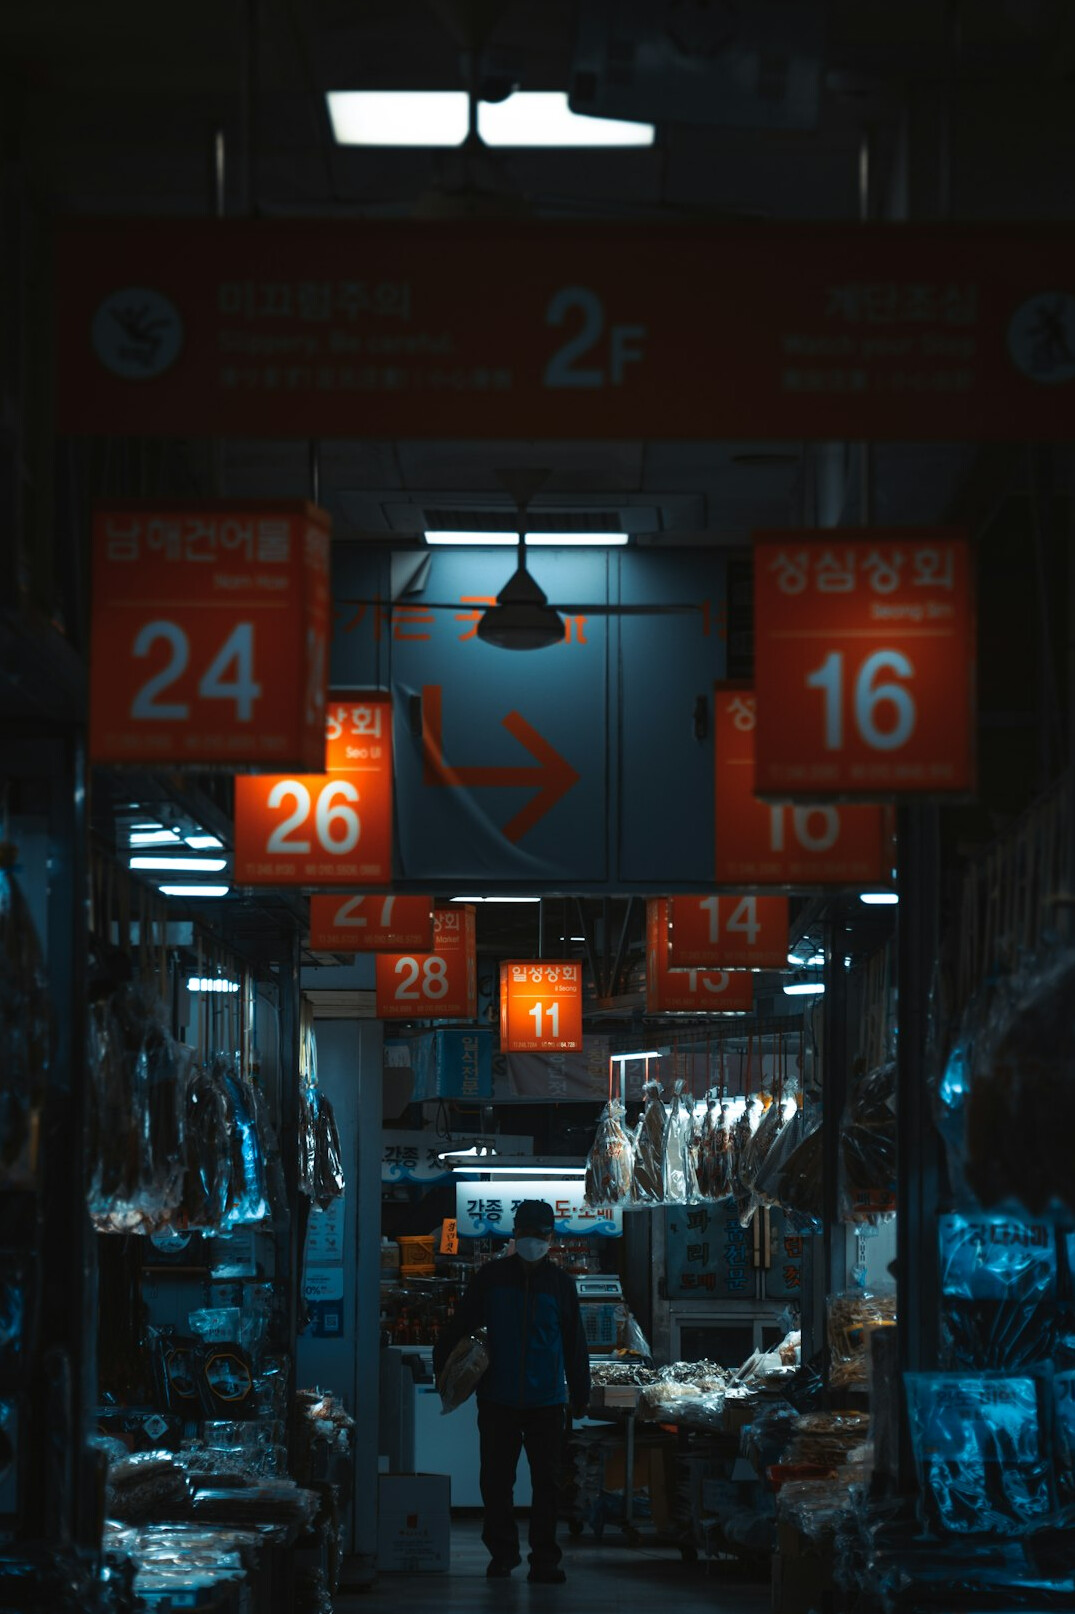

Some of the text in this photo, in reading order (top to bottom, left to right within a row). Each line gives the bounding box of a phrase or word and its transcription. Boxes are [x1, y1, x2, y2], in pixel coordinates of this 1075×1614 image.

[543, 286, 647, 388] 2F
[769, 549, 954, 595] 성심상회
[333, 594, 435, 640] 가는
[131, 619, 261, 722] 24
[806, 649, 916, 751] 16
[266, 779, 361, 856] 26
[699, 896, 761, 945] 14
[394, 956, 448, 1000] 28
[512, 966, 576, 983] 일성상회
[528, 1002, 559, 1038] 11
[382, 1146, 420, 1168] 각종
[467, 1199, 503, 1222] 각종
